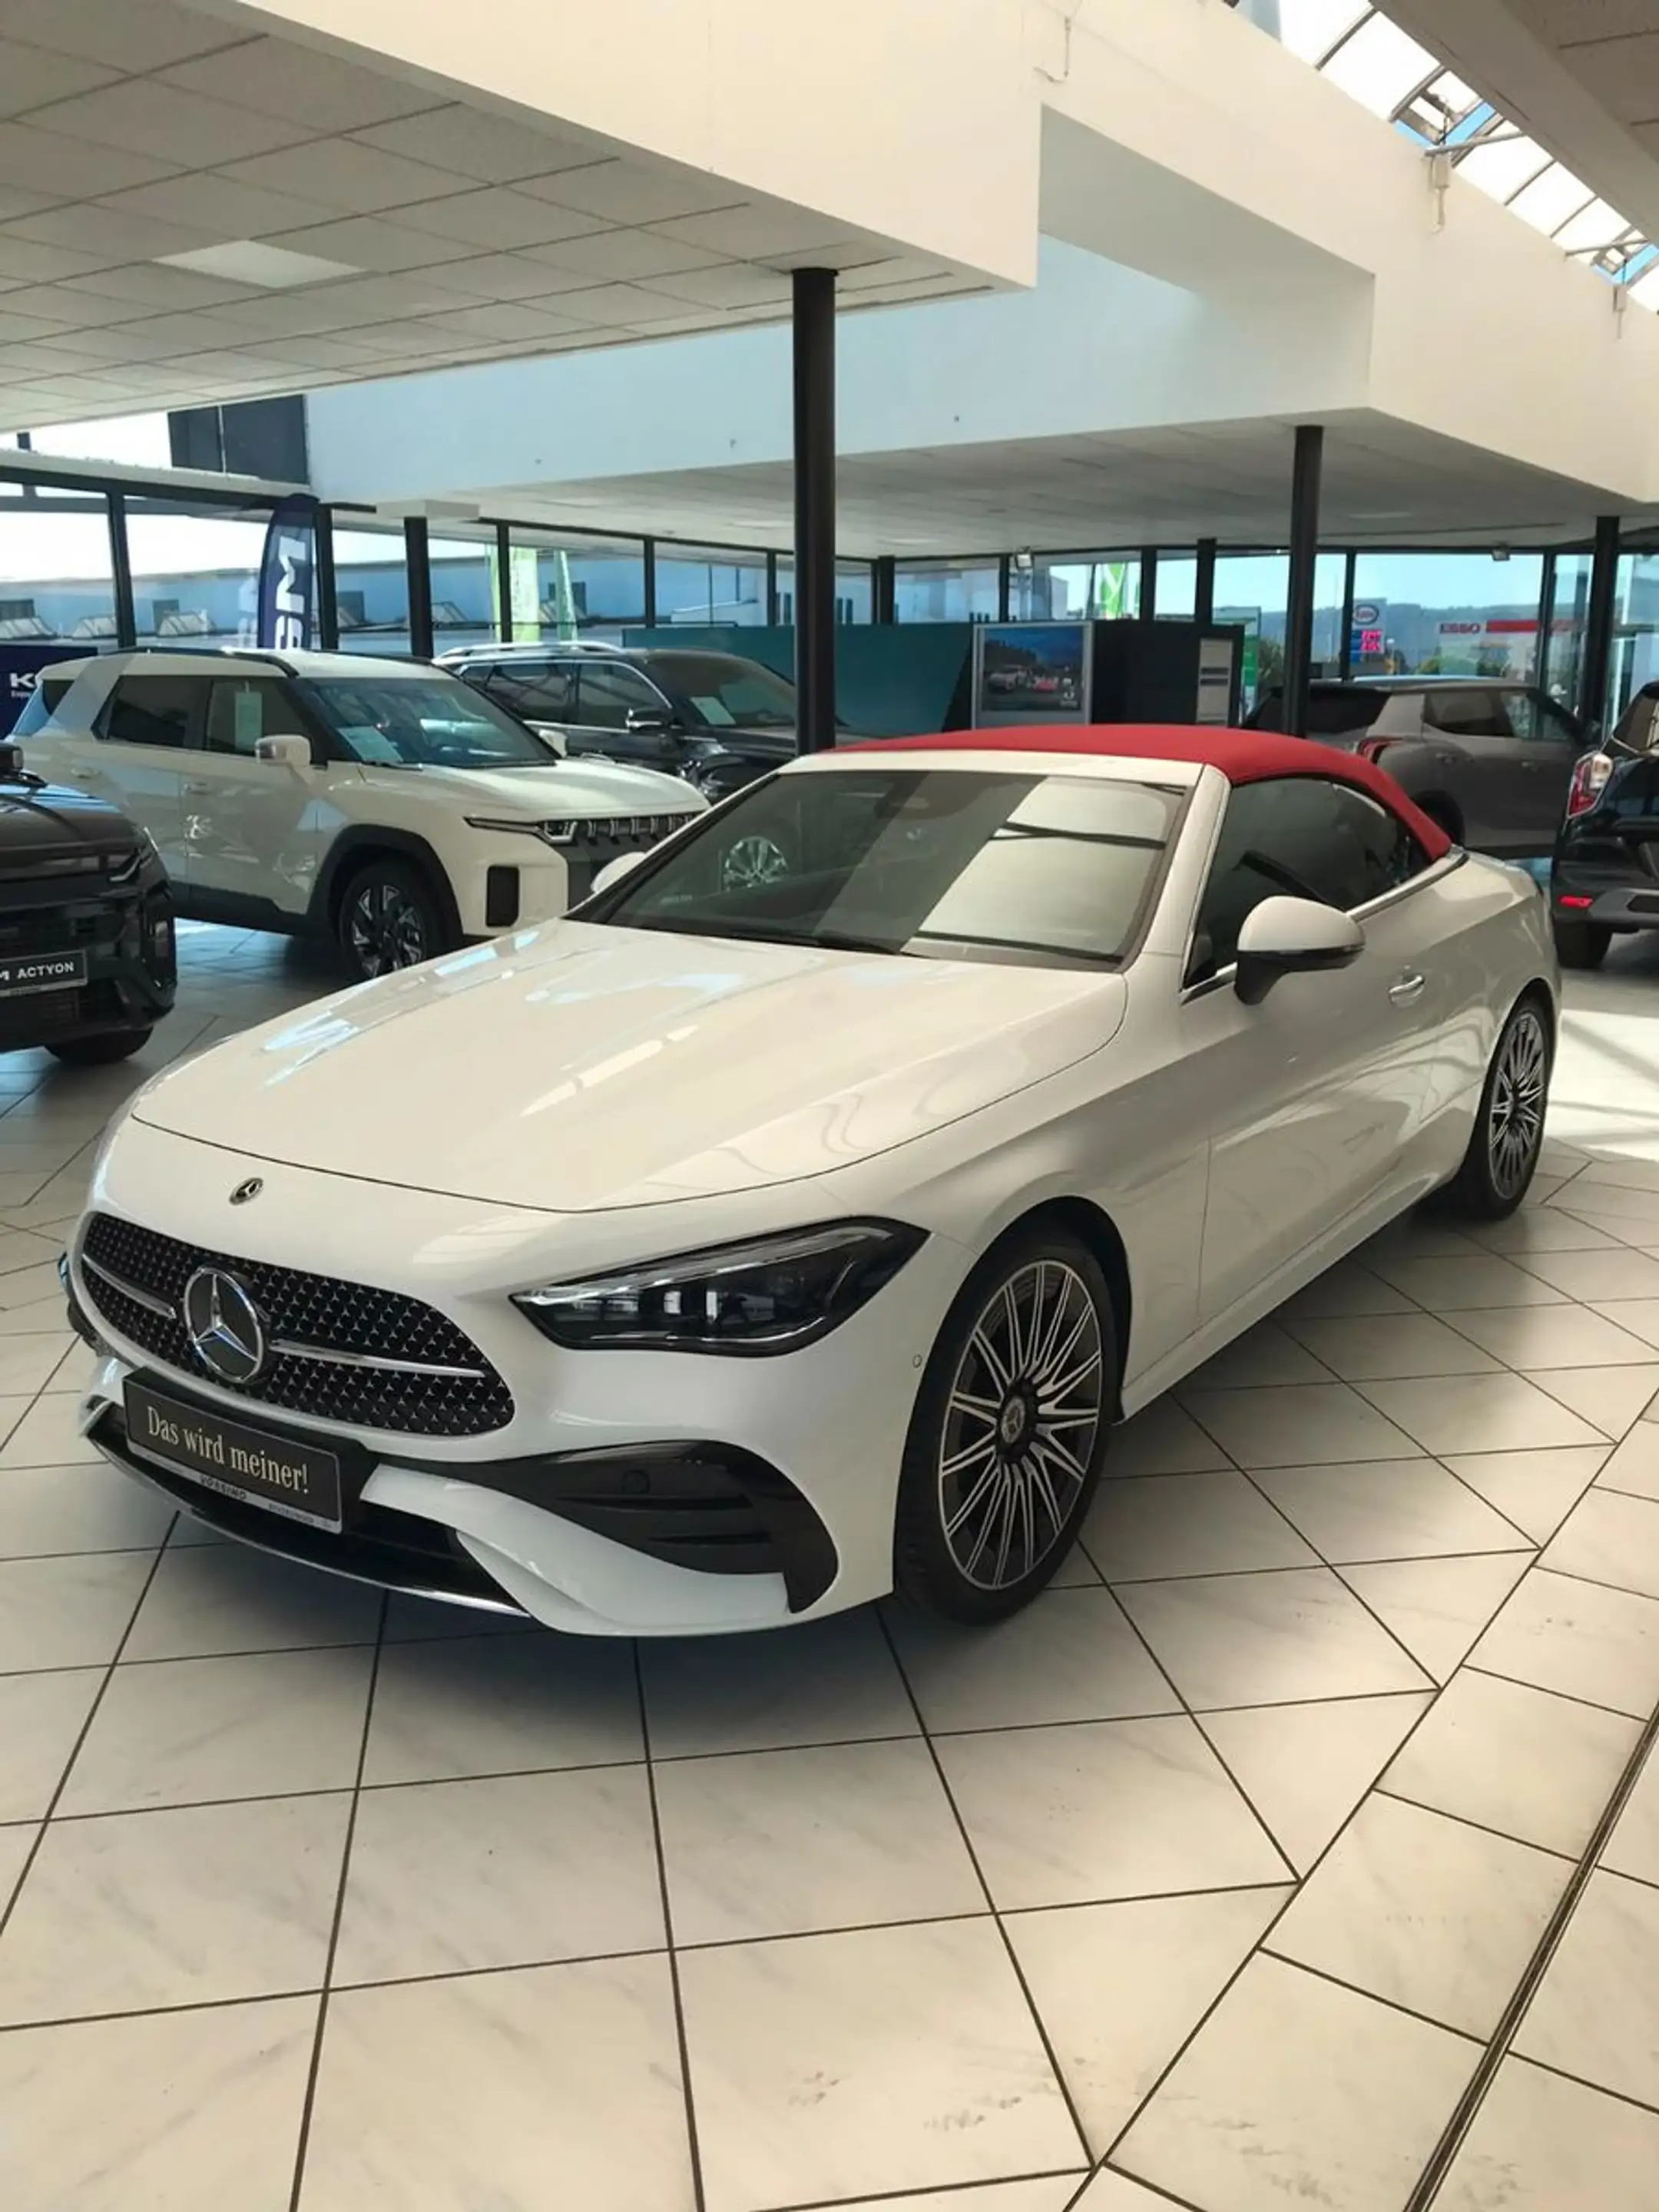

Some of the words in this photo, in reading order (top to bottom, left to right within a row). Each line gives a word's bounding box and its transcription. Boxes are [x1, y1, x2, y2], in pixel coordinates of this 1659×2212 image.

[17, 961, 75, 979] ACTYON
[147, 1406, 180, 1445] Das
[183, 1428, 224, 1465] wird
[230, 1446, 310, 1494] meiner!
